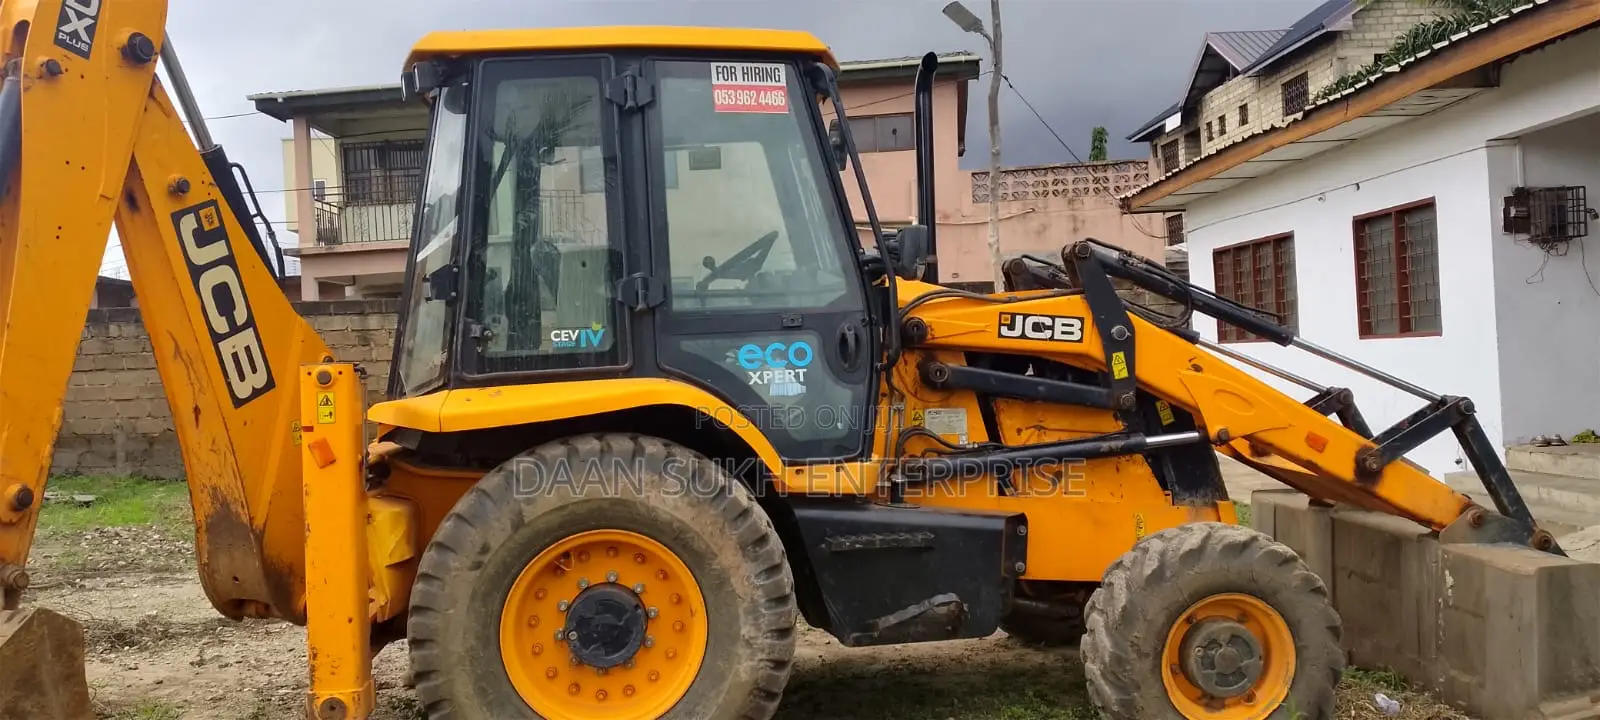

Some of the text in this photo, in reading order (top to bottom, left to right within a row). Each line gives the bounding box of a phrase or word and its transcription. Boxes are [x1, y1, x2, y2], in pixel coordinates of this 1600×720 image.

[58, 32, 89, 51] PLUS
[716, 66, 781, 83] FOR HIRING
[714, 89, 785, 106] 053 962 4466
[179, 212, 268, 399] JCB
[1000, 315, 1082, 341] JCB
[551, 328, 605, 348] CEV IV
[738, 342, 813, 369] eco
[748, 368, 807, 385] XPERT
